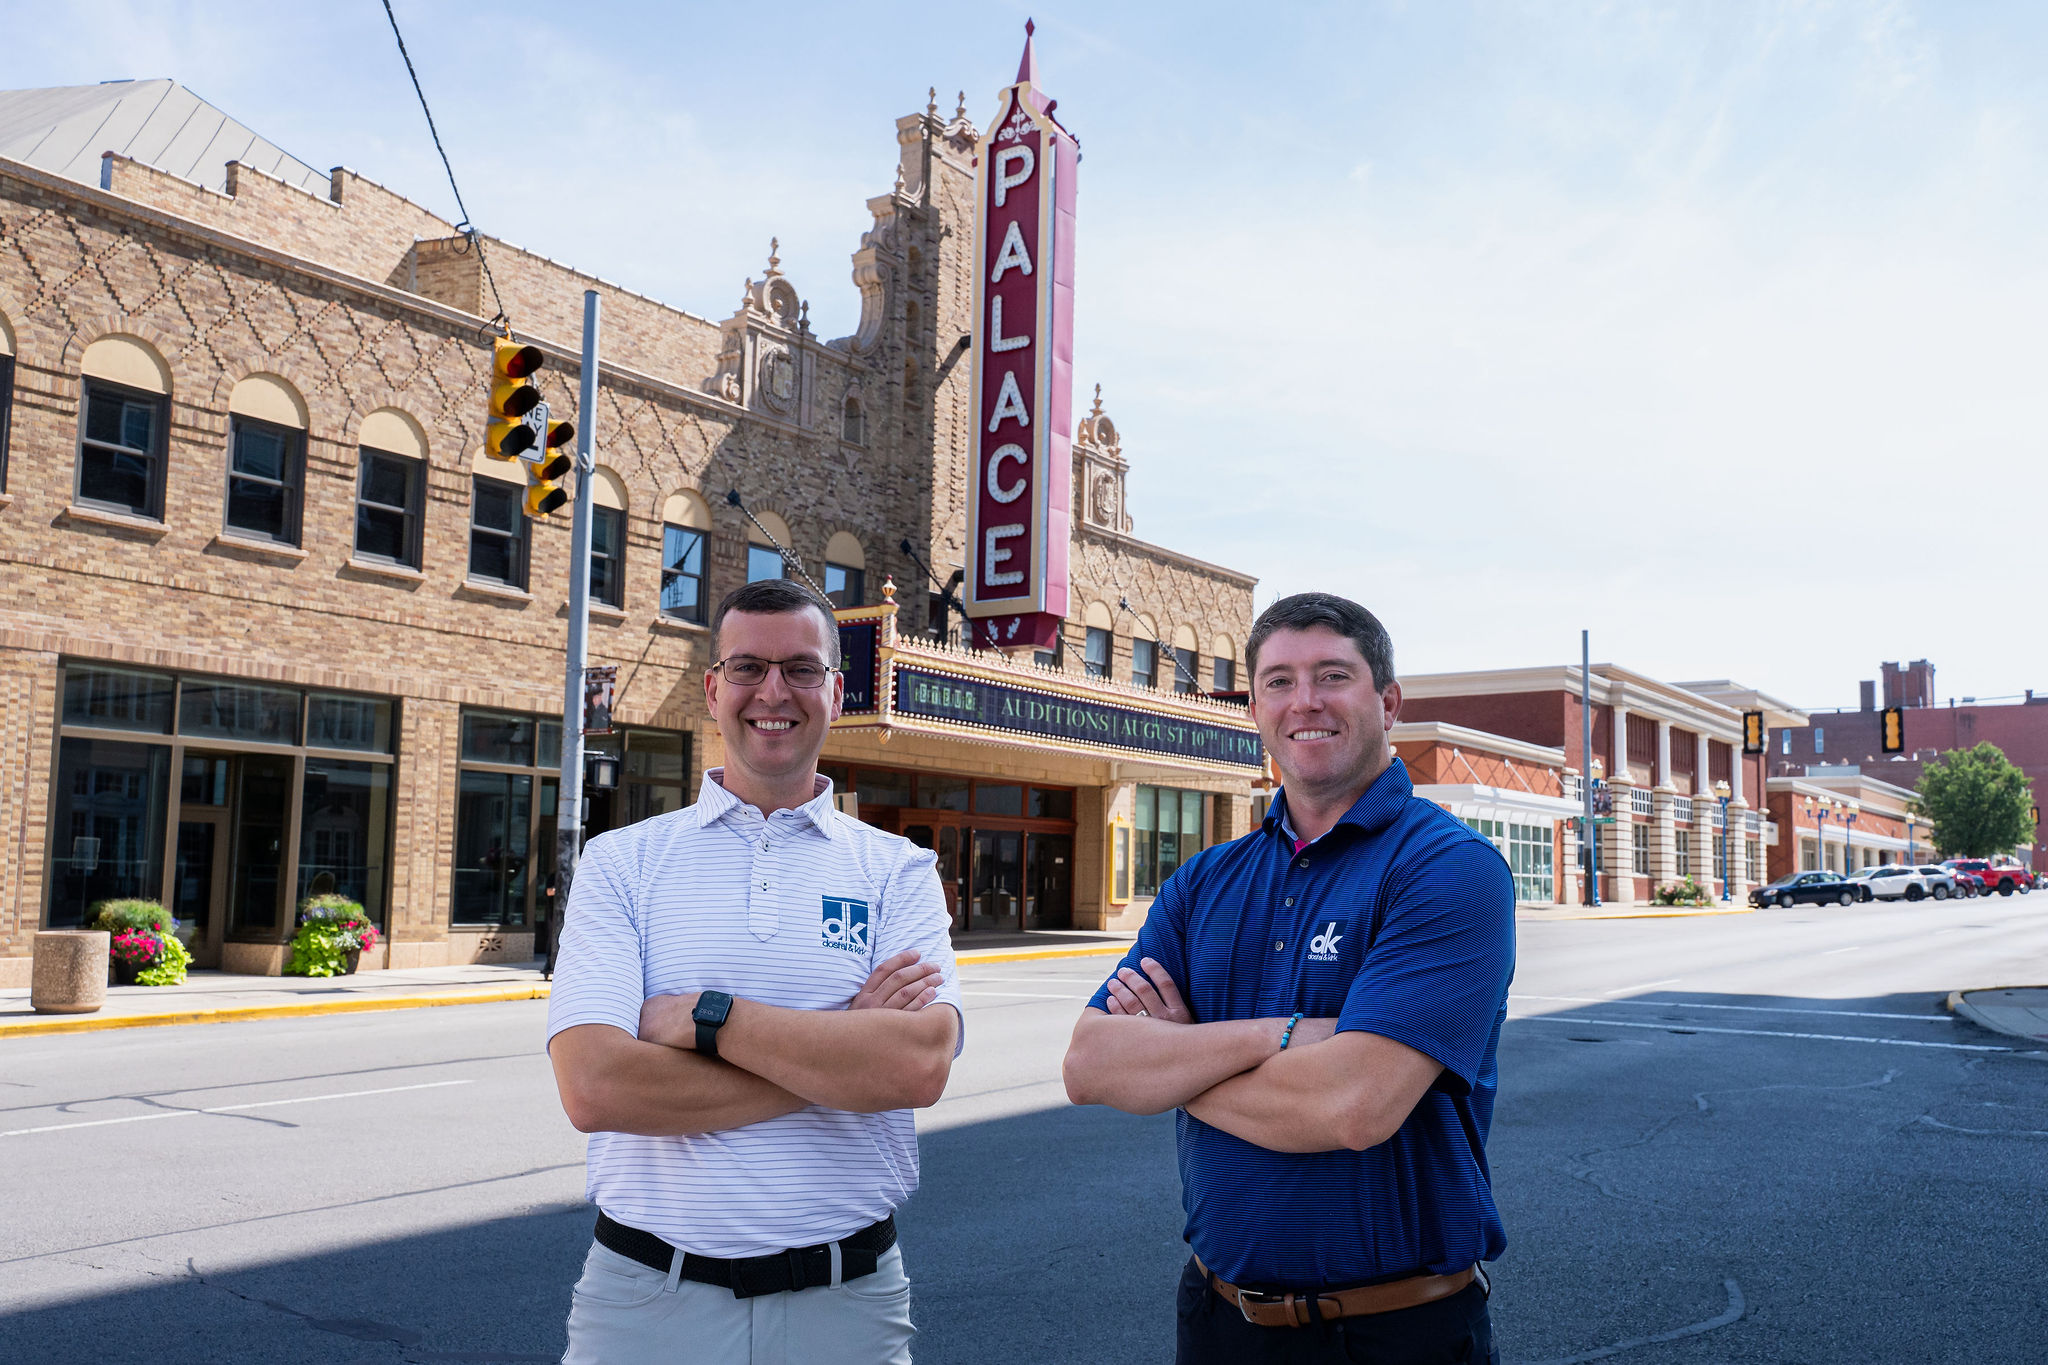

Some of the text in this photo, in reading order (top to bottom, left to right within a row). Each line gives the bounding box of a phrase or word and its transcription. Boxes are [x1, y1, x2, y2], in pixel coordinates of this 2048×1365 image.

[985, 145, 1035, 587] PALACE
[1001, 697, 1109, 732] AUDITIONS
[1120, 717, 1187, 744] AUGUST
[1237, 737, 1257, 756] PM
[822, 901, 868, 947] dk
[1310, 922, 1344, 954] dk
[848, 943, 854, 953] &
